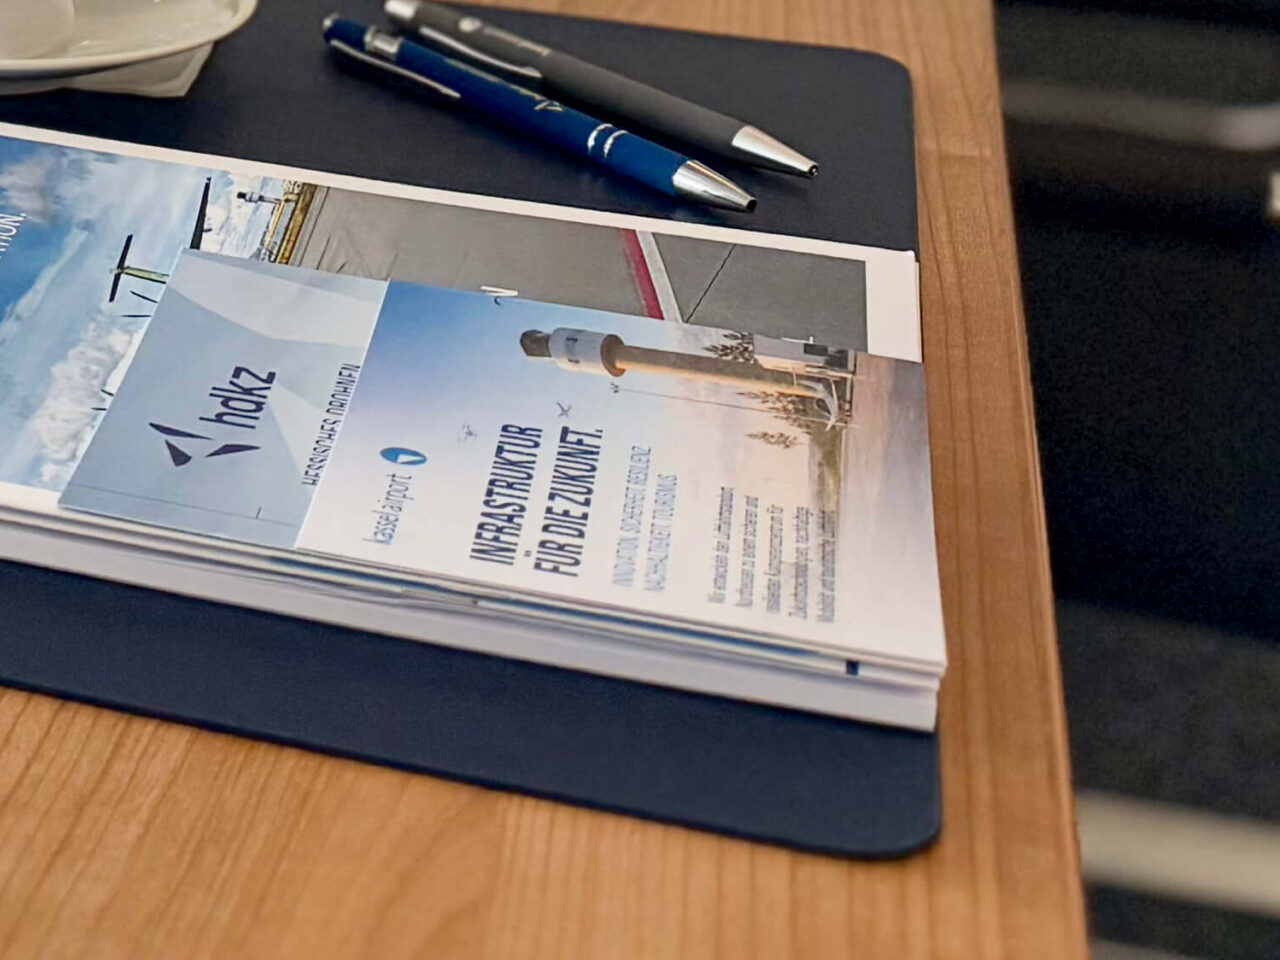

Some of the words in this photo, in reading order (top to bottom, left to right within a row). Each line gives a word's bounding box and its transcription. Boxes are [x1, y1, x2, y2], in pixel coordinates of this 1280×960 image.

[198, 366, 276, 429] hdkz
[301, 418, 341, 486] HESSISCHES
[326, 363, 361, 416] DROHNEN
[376, 473, 415, 513] airport
[470, 424, 543, 565] INFRASTRUKTUR
[548, 426, 603, 507] ZUKUNFT.
[541, 505, 589, 539] DIE
[524, 540, 583, 577] FÜR
